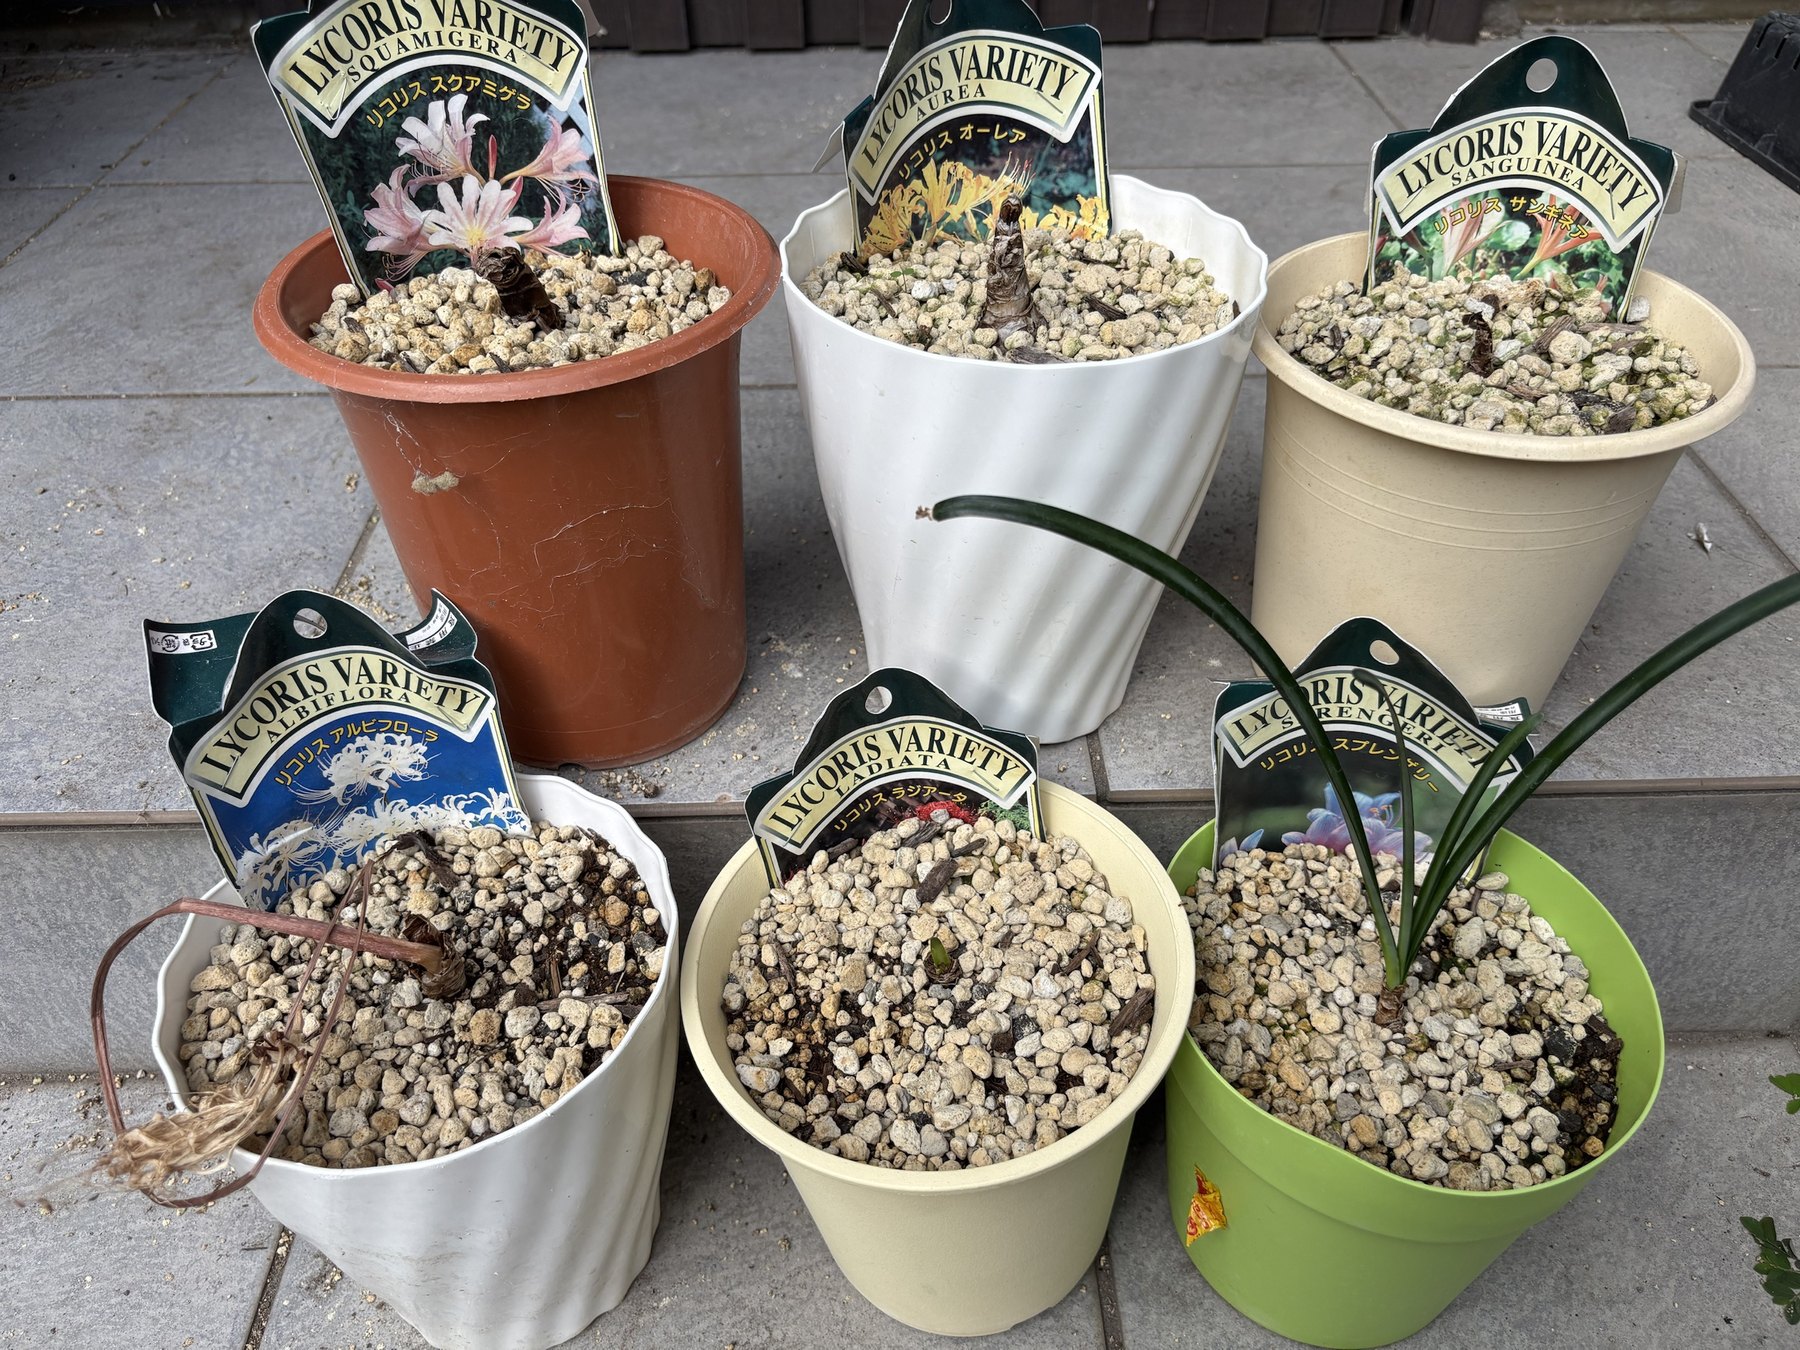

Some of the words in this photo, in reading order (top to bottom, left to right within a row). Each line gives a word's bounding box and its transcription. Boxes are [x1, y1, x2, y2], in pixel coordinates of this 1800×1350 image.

[289, 0, 423, 95] LYCORIS
[430, 0, 575, 73] VARIETY
[347, 30, 518, 83] SQUAMIGERA
[366, 80, 428, 129] リコリス
[431, 74, 532, 110] スクアミゲラ
[861, 55, 944, 168] LYCORIS
[948, 44, 1078, 100] VARIETY
[916, 83, 986, 122] AUREA
[898, 131, 953, 180] リコリス
[959, 123, 1027, 145] オーレア
[1395, 120, 1526, 199] LYCORIS
[1536, 120, 1648, 212] VARIETY
[1451, 157, 1584, 192] SANGUINEA
[1434, 197, 1502, 235] リコリス
[1509, 196, 1589, 239] サンギネア
[200, 663, 328, 775] LYCORIS
[331, 656, 480, 715] VARIETY
[266, 685, 412, 743] ALBIFLORA
[1281, 706, 1443, 755] SRENGERI
[275, 739, 330, 787] リコリス
[330, 719, 439, 743] アルビフローラ
[769, 734, 882, 832] LYCORIS
[886, 726, 1020, 781] VARIETY
[835, 754, 951, 798] LADIATA
[1260, 742, 1317, 772] リコリ
[834, 792, 888, 831] リコリス
[892, 784, 967, 803] ラジアータ
